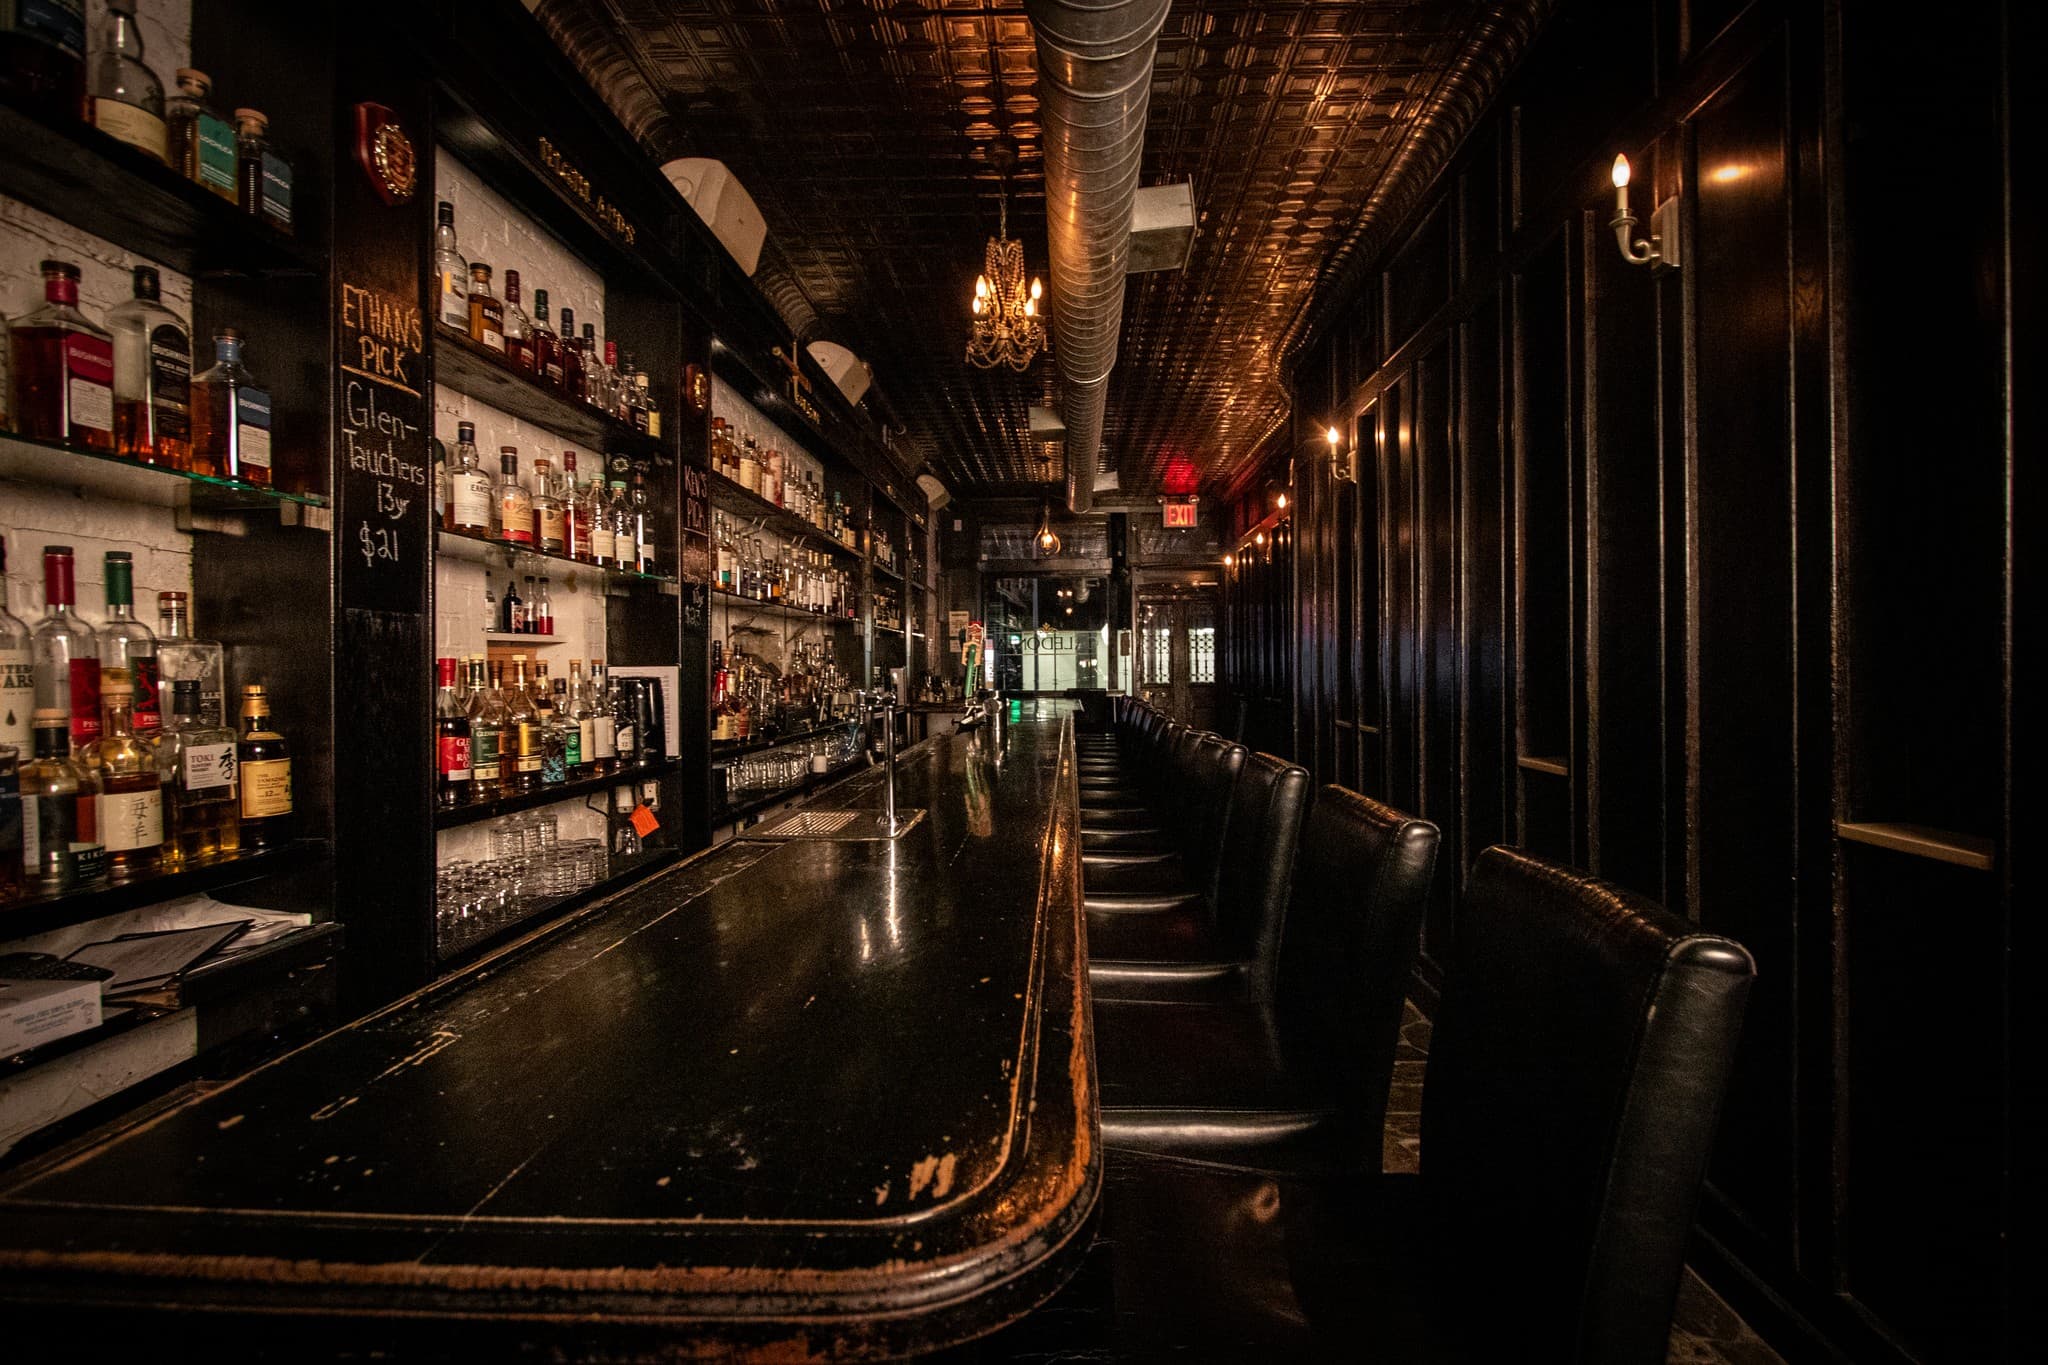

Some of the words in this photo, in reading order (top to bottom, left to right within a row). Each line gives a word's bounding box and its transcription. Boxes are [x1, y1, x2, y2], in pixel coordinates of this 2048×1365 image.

[343, 283, 422, 354] ETHAN'S
[358, 336, 408, 384] PICK
[347, 381, 418, 441] Glen-
[343, 429, 425, 485] Tauchers
[1168, 505, 1194, 525] EXIT
[360, 520, 399, 568] $21
[191, 754, 214, 764] TOKI
